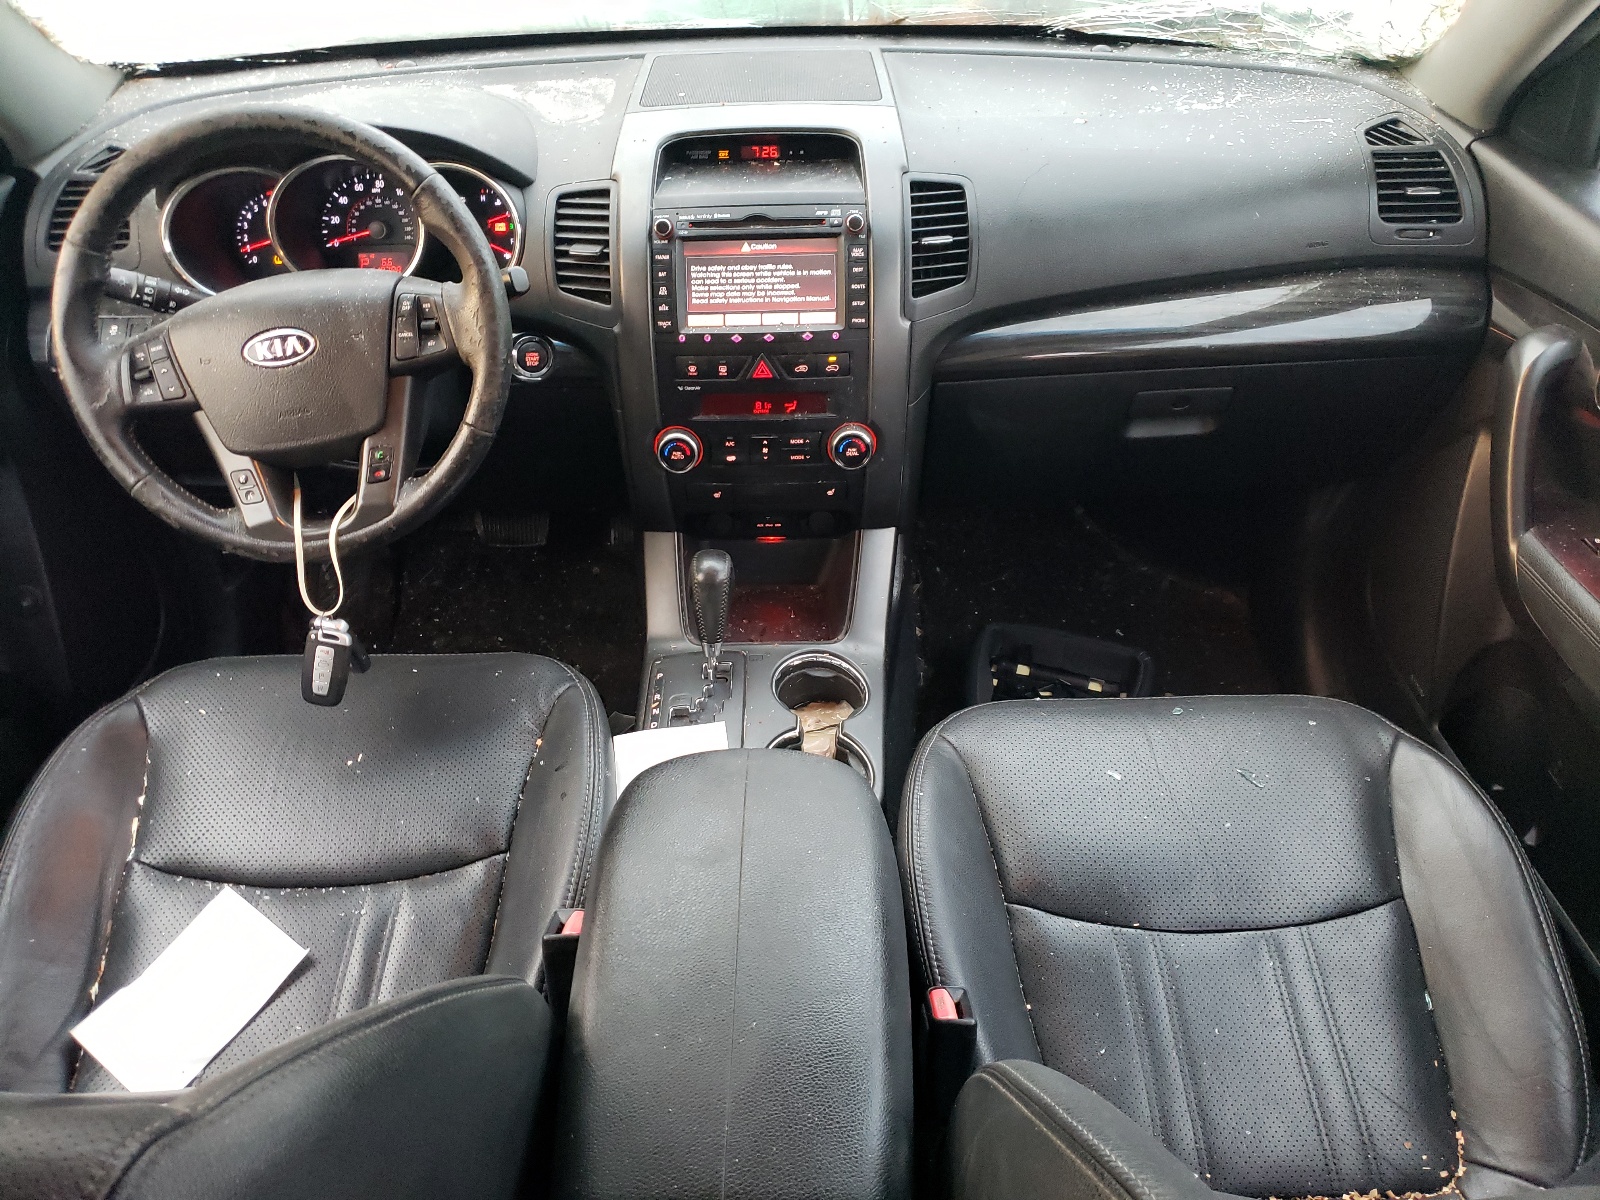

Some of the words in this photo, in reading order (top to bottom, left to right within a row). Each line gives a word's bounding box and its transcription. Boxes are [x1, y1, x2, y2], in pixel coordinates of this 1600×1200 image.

[354, 183, 364, 192] 60
[375, 180, 384, 188] 80
[262, 199, 267, 207] 6
[338, 196, 348, 204] 40
[331, 216, 340, 224] 20
[334, 239, 339, 247] 0
[254, 336, 305, 361] KIA
